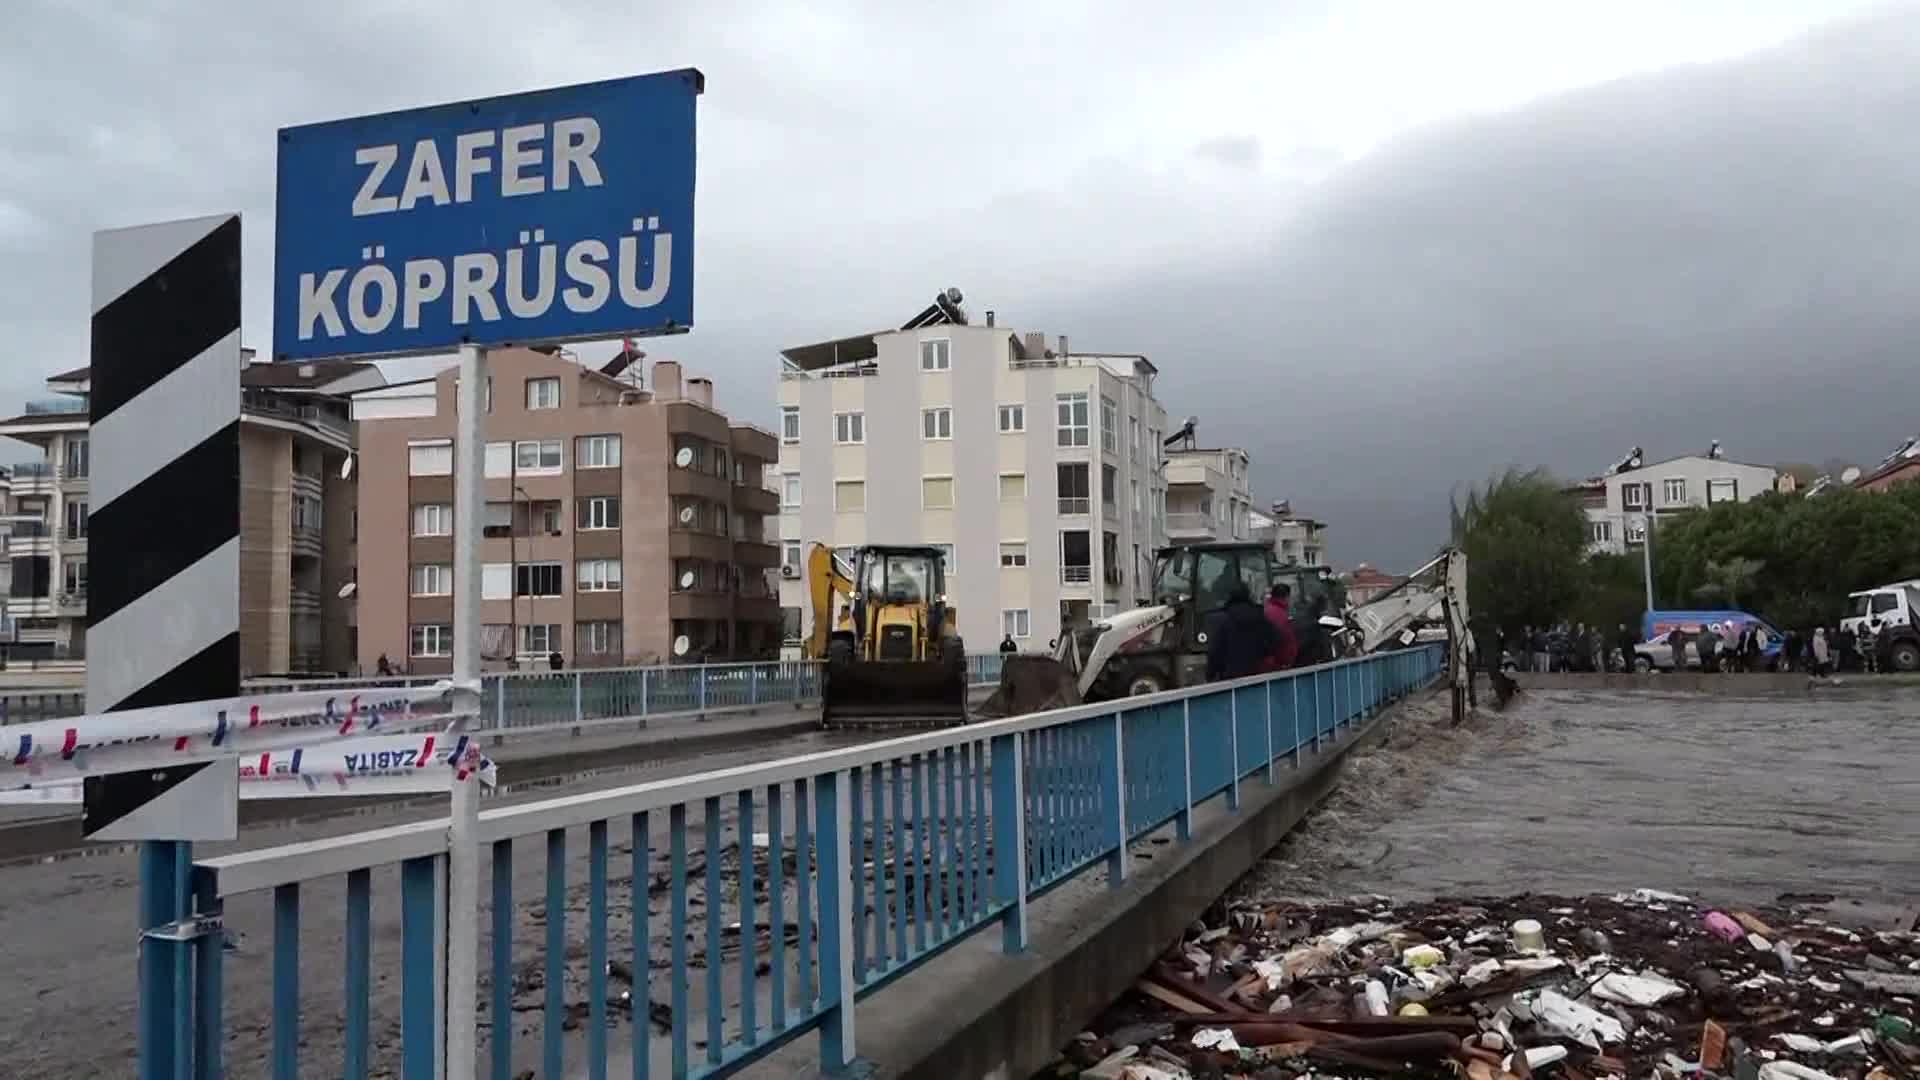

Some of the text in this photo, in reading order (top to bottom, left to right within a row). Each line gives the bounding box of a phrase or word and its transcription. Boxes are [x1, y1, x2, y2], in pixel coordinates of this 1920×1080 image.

[352, 117, 603, 216] ZAFER
[298, 216, 673, 340] KÖPRÜSÜ
[344, 750, 418, 772] ZABITA
